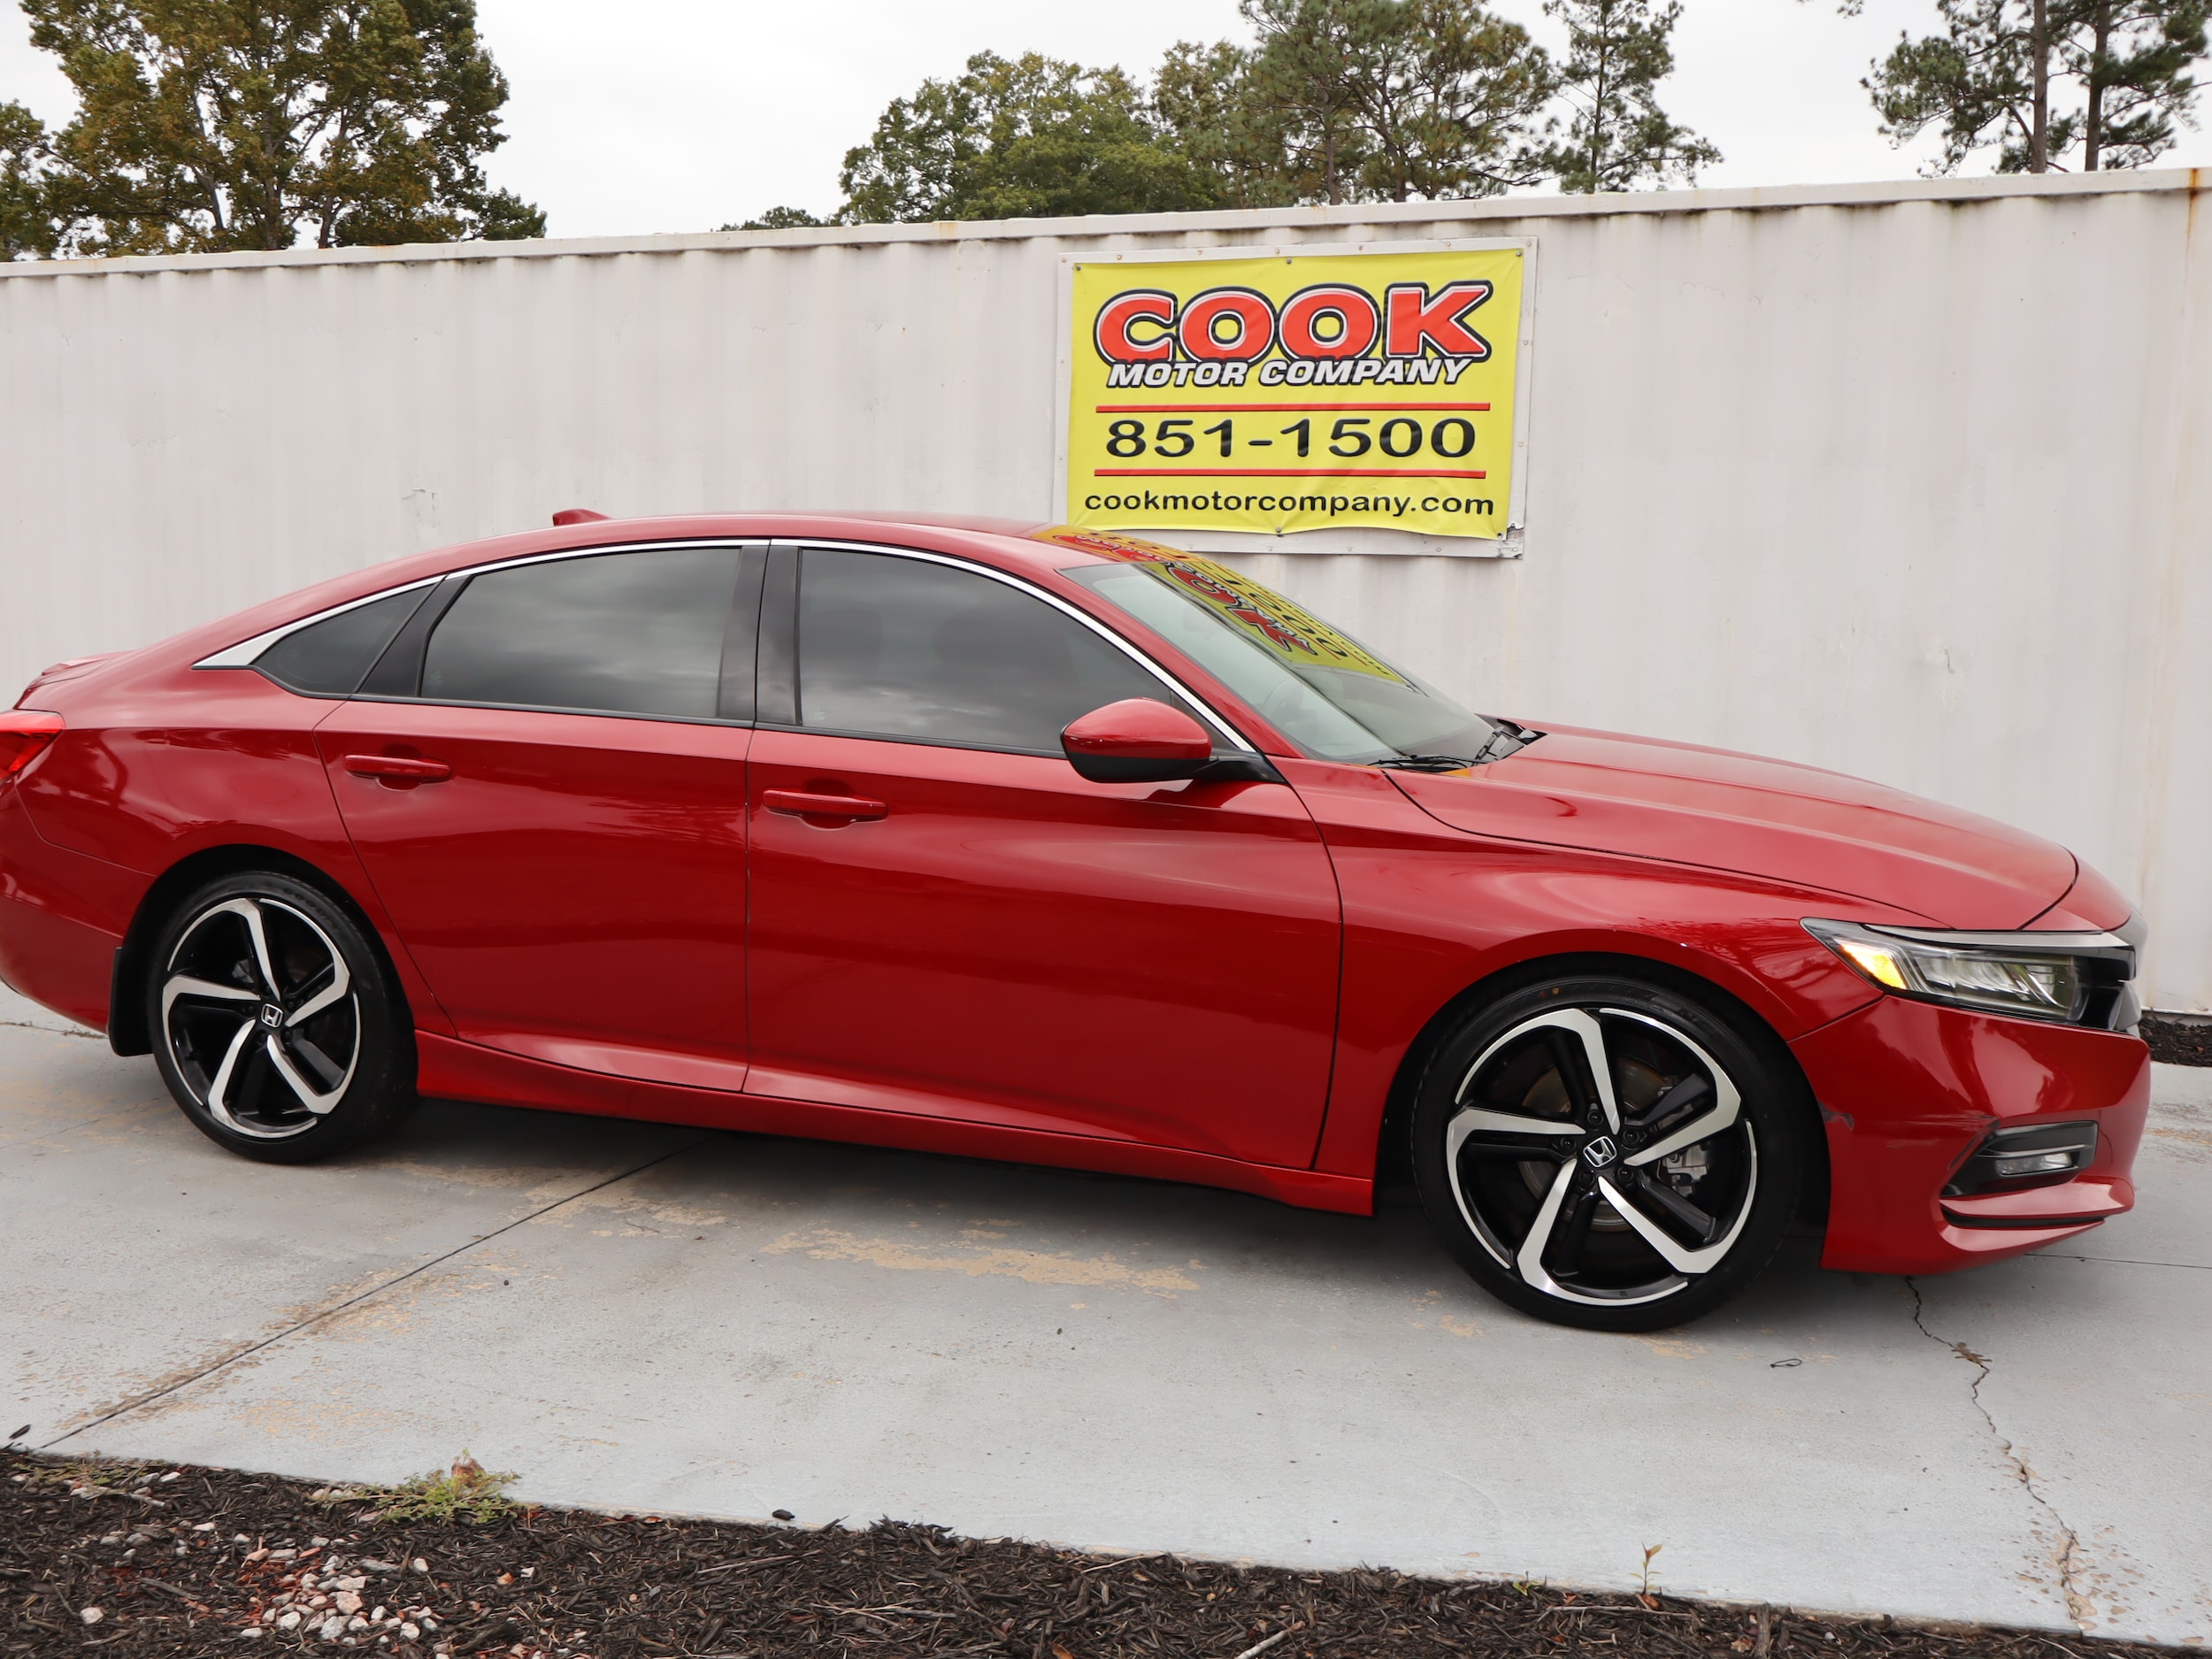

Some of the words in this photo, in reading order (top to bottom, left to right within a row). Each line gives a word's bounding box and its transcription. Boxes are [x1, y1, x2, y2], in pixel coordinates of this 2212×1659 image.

[1094, 280, 1493, 365] COOK
[1107, 361, 1247, 388] MOTOR
[1257, 357, 1473, 387] COMPANY
[1105, 418, 1477, 458] 851-1500
[1085, 489, 1494, 518] cookmotorcompany.com
